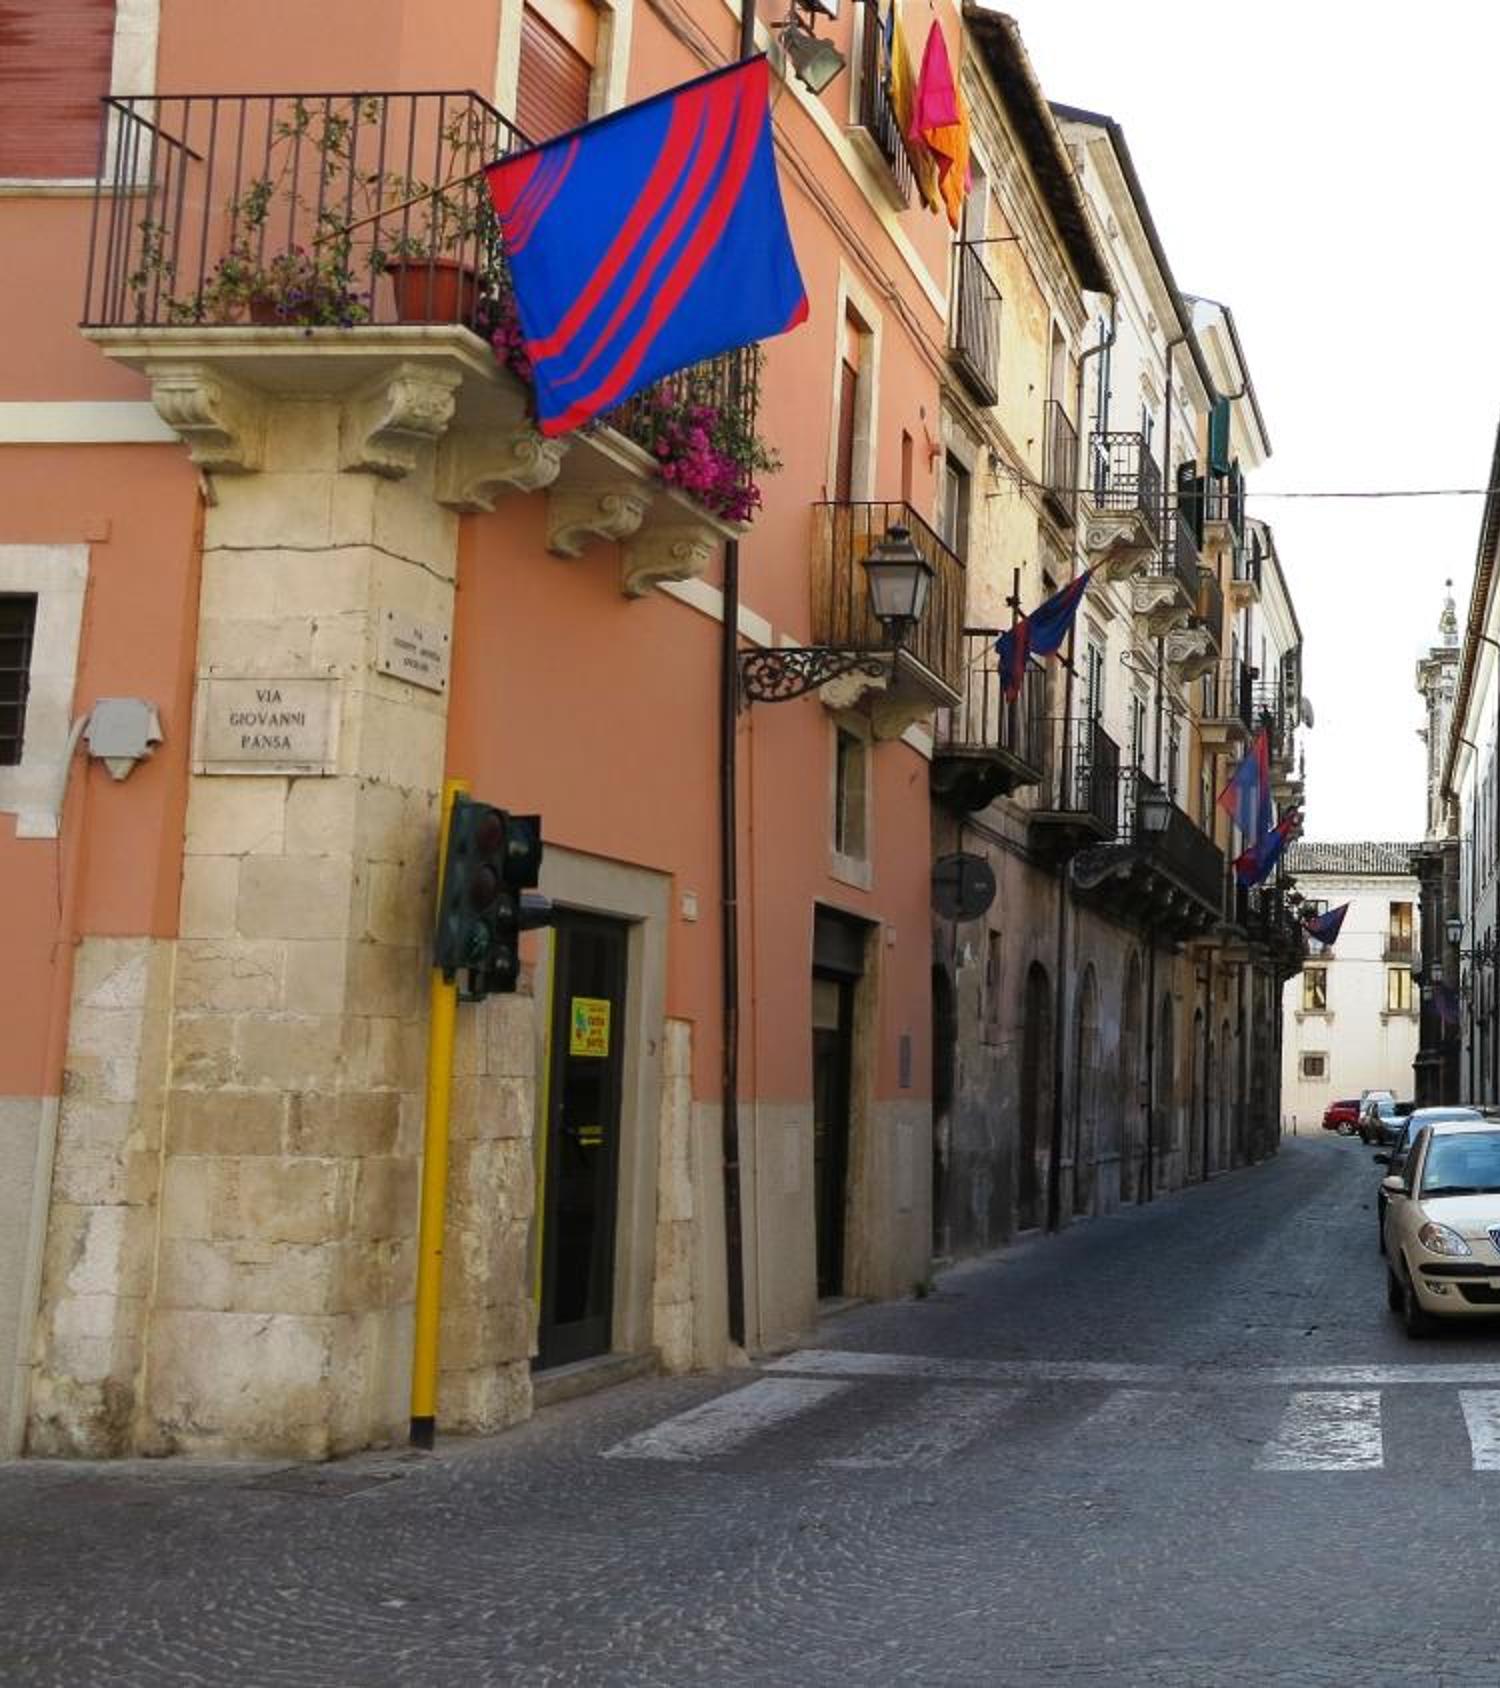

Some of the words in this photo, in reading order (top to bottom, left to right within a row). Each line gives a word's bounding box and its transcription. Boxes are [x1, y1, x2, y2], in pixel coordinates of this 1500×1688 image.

[255, 689, 282, 703] VIA
[229, 712, 306, 727] GIOVANNI
[240, 735, 292, 750] PANSA
